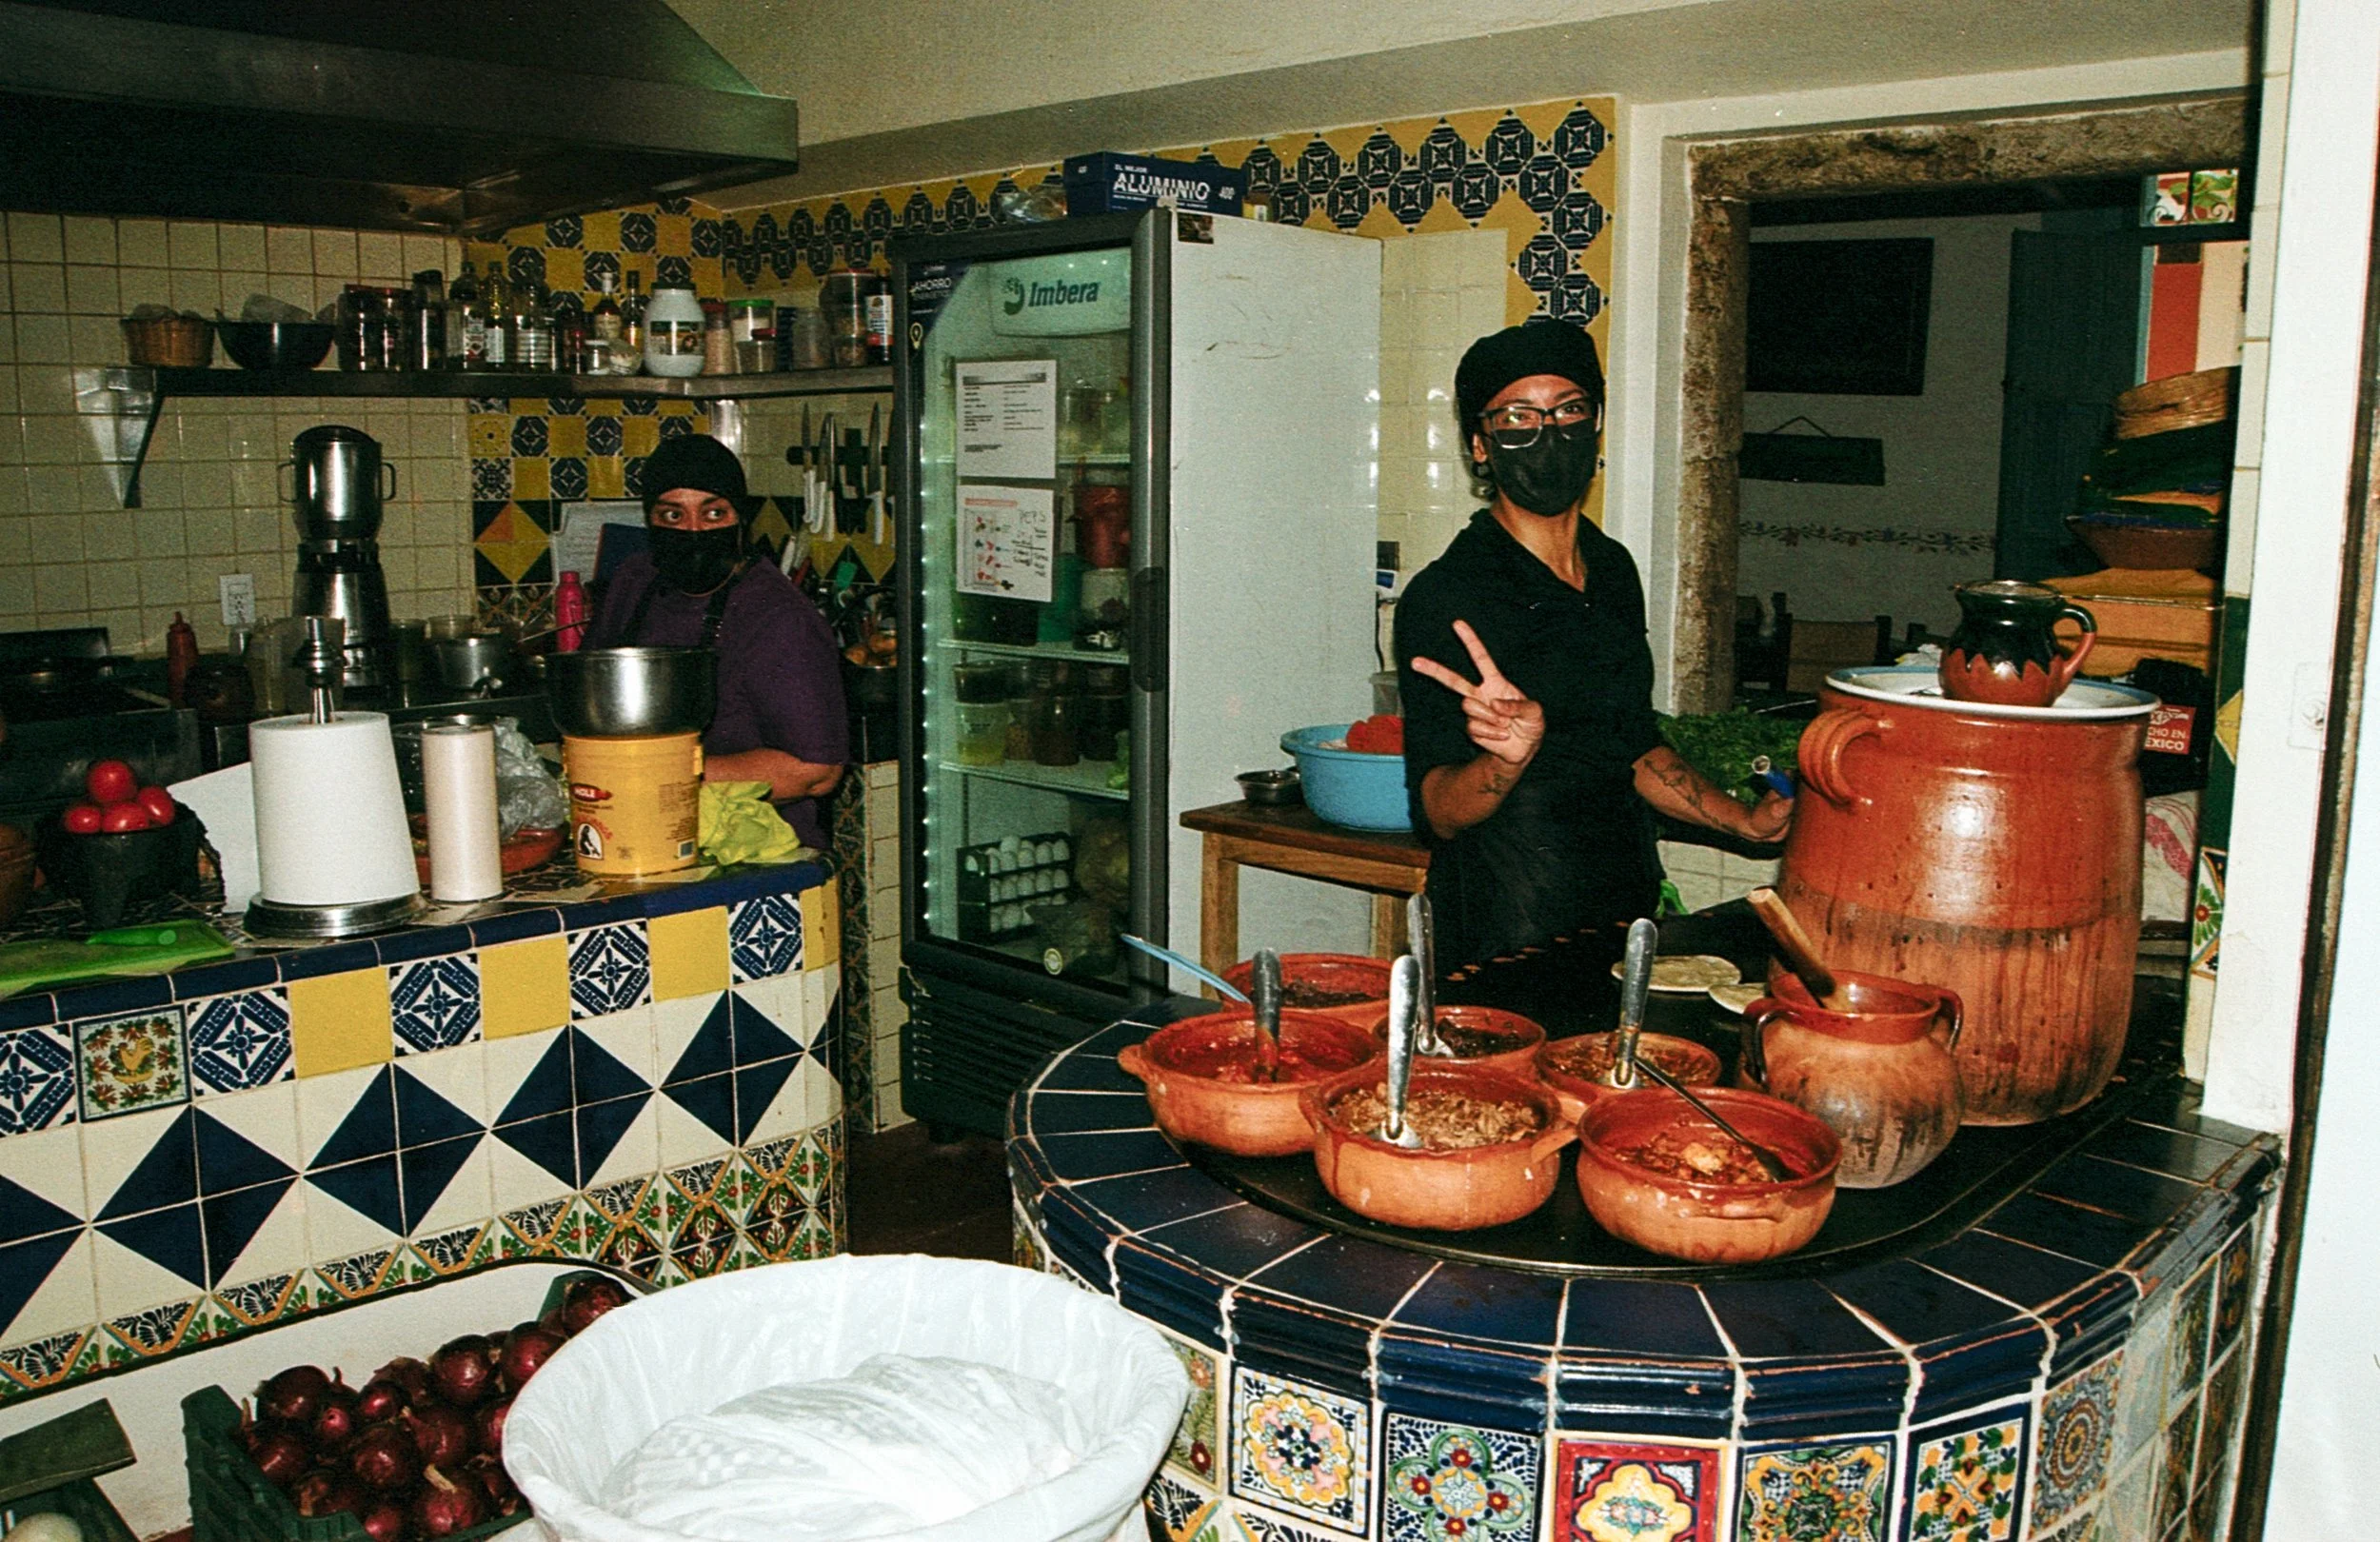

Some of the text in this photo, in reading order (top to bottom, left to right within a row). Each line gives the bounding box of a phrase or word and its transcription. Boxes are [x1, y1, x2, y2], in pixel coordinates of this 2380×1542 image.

[1113, 172, 1211, 201] ALUMINIO
[1028, 279, 1101, 306] Imbera
[2147, 726, 2169, 737] CHO
[2145, 737, 2185, 751] EXICO
